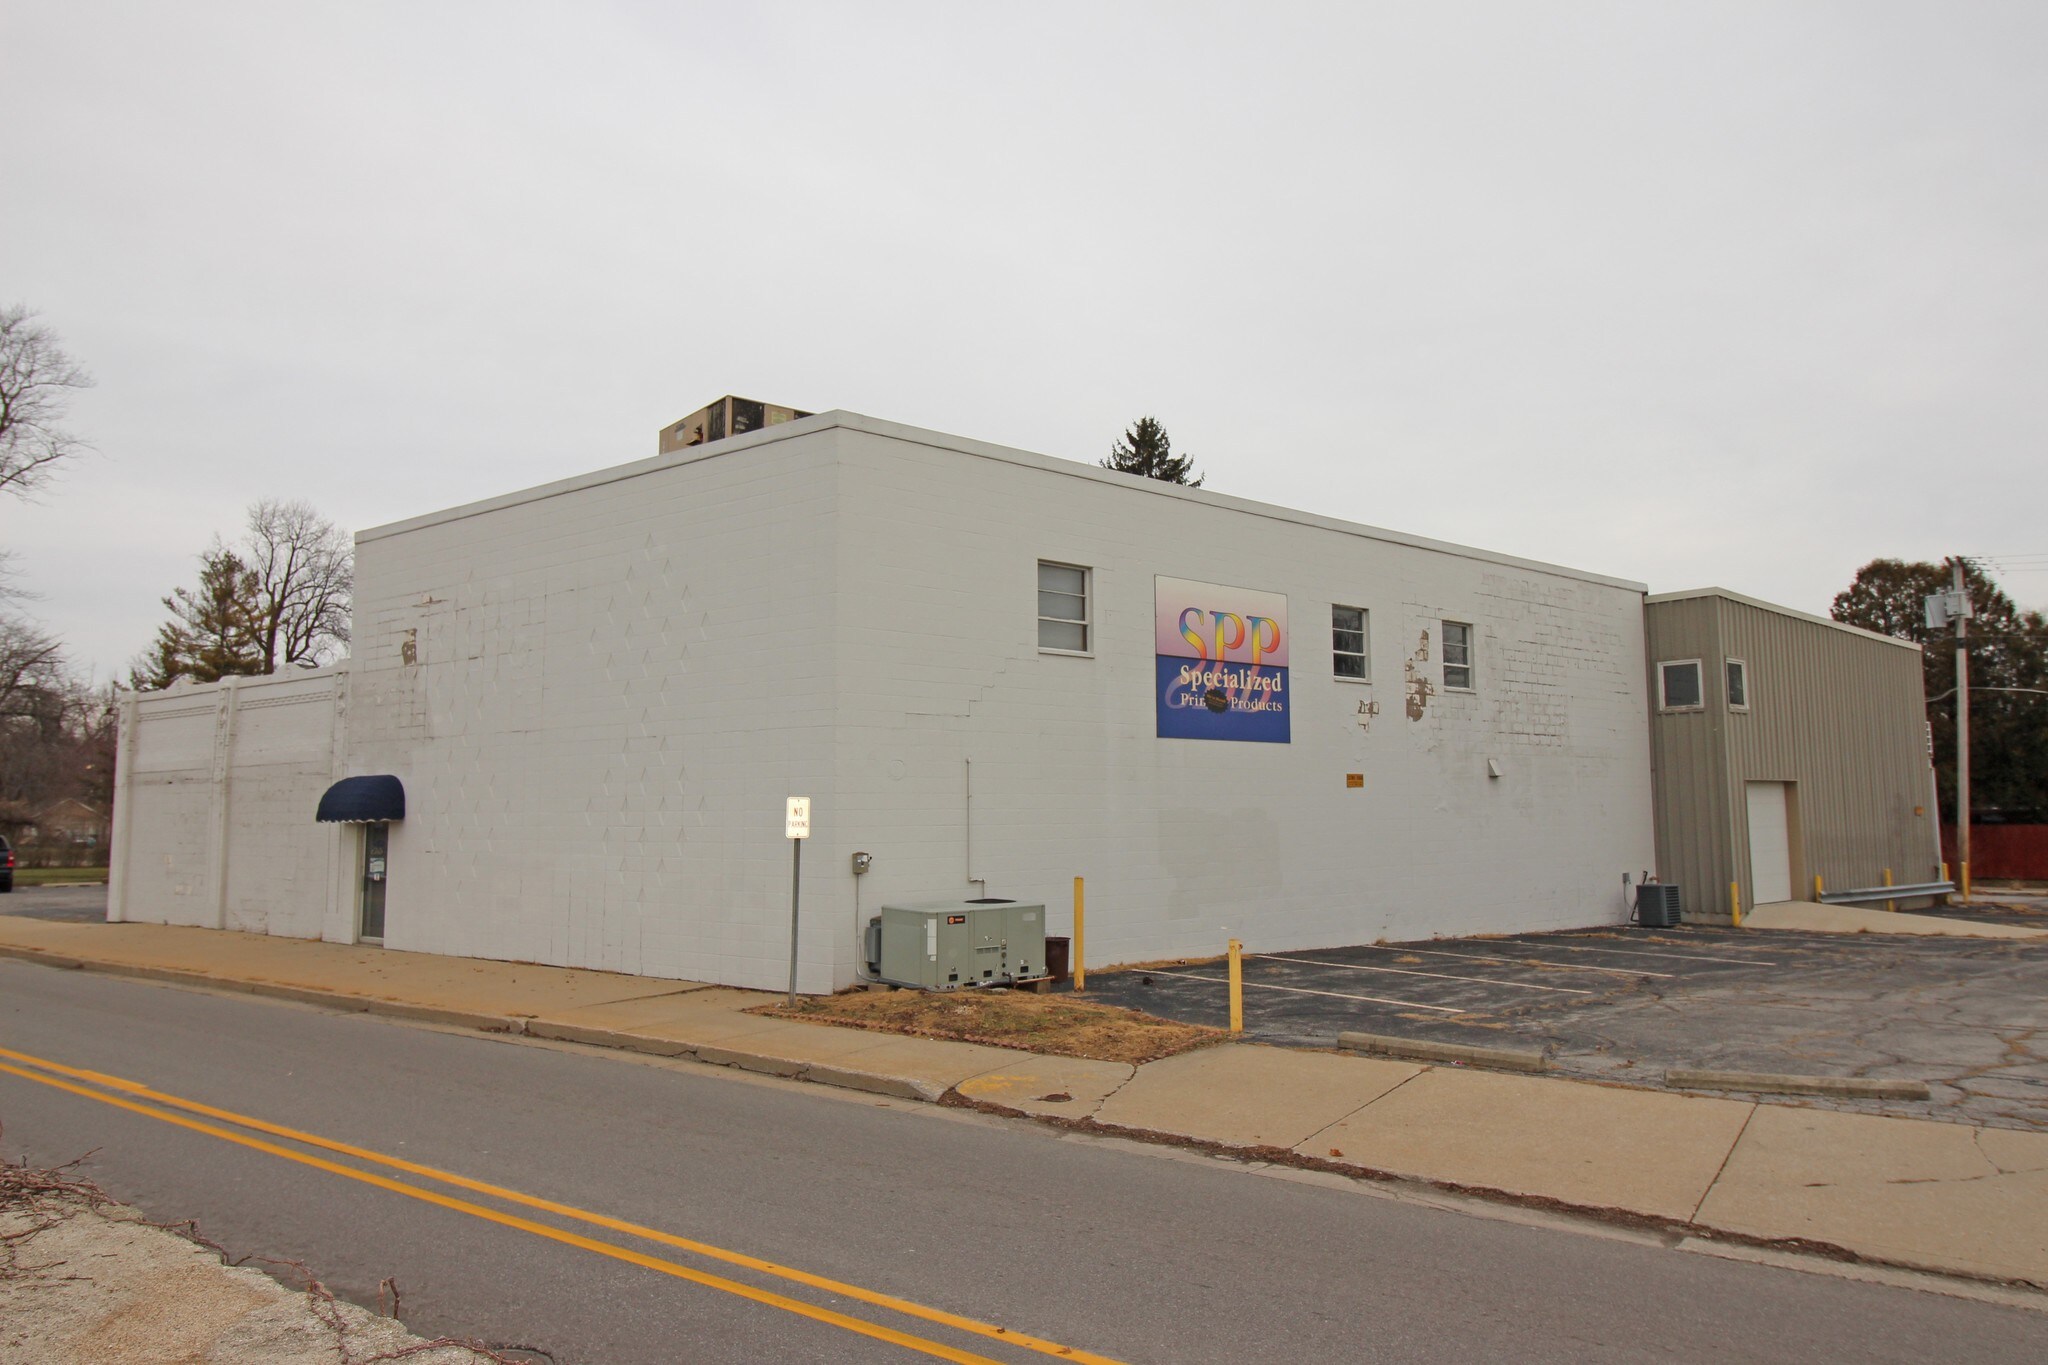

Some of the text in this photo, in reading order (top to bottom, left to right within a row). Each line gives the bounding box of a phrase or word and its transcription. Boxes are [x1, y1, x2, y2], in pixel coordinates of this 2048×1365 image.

[1179, 607, 1281, 664] SPP
[1180, 665, 1282, 692] Specialized
[1181, 692, 1207, 708] Prin
[1231, 697, 1283, 711] Products
[793, 807, 803, 817] NO
[788, 820, 808, 828] PARKING
